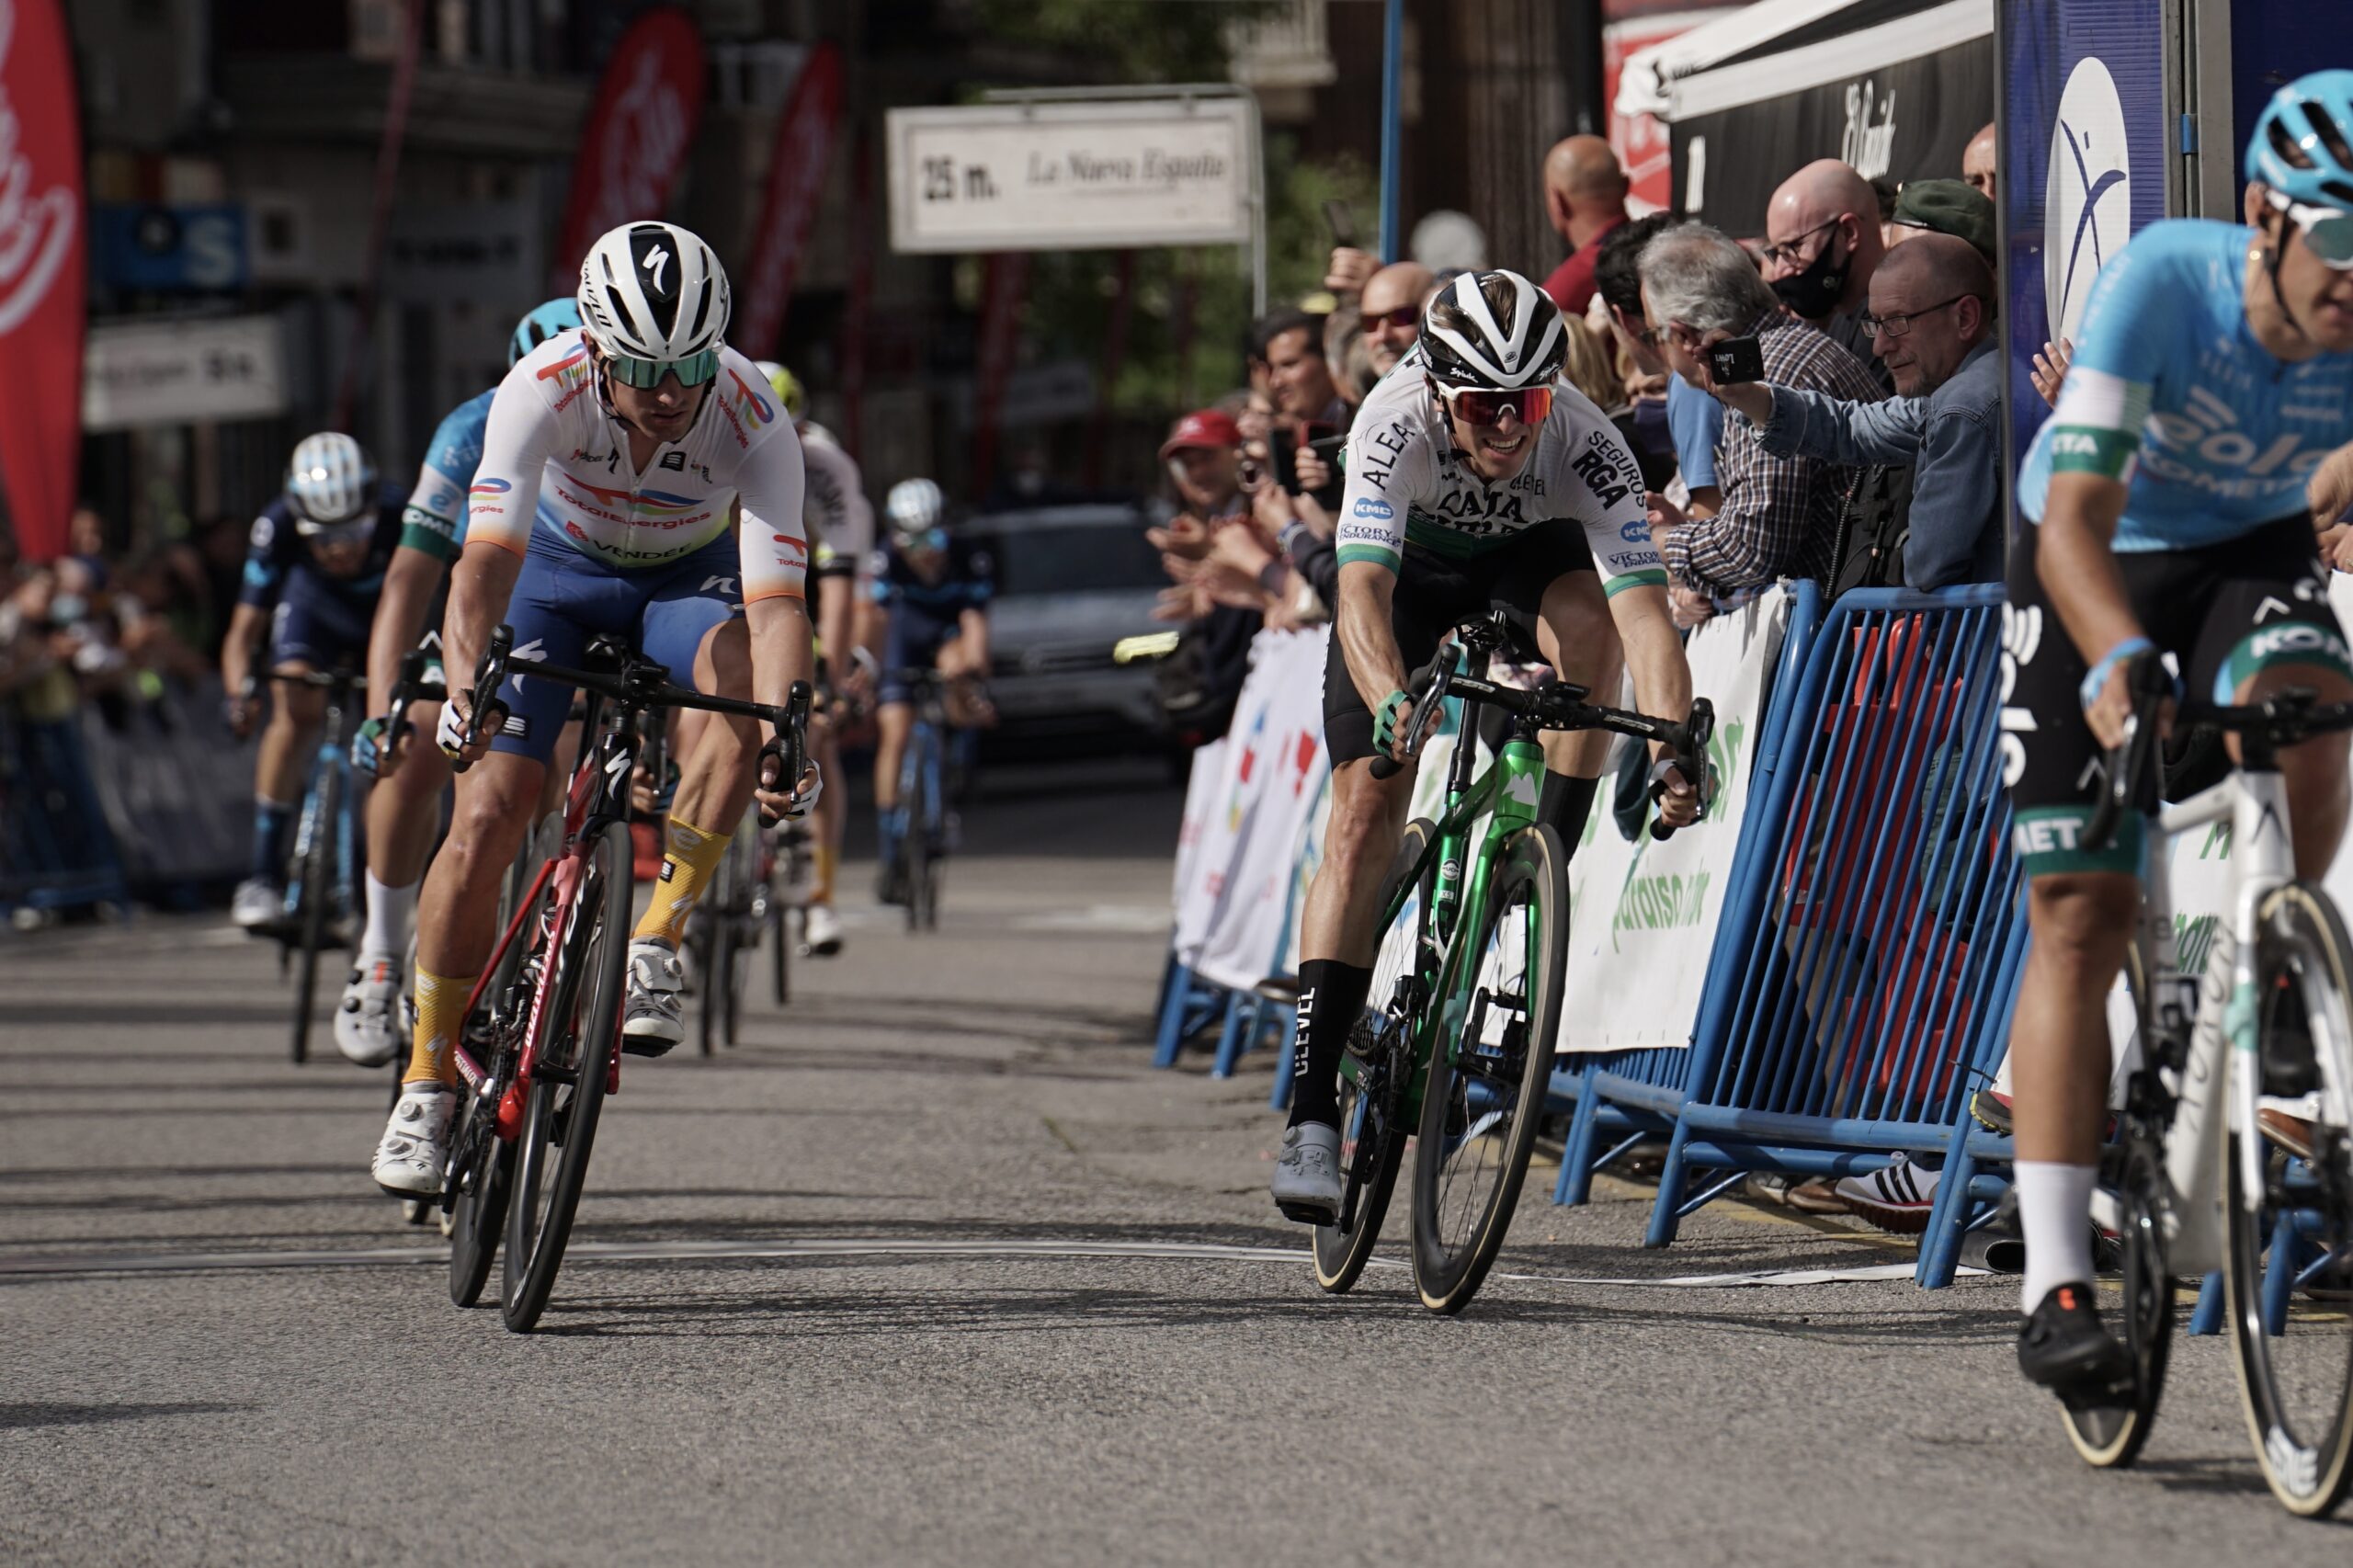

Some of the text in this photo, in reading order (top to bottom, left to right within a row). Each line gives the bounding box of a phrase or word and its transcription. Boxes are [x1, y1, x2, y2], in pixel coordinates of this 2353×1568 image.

[923, 154, 954, 200] 25
[1026, 152, 1058, 183] La
[1362, 422, 1415, 493] ALEA
[1572, 449, 1629, 510] RGA
[1588, 430, 1646, 508] SEGUROS
[1355, 503, 1392, 516] KMC
[1438, 489, 1529, 524] CAJA
